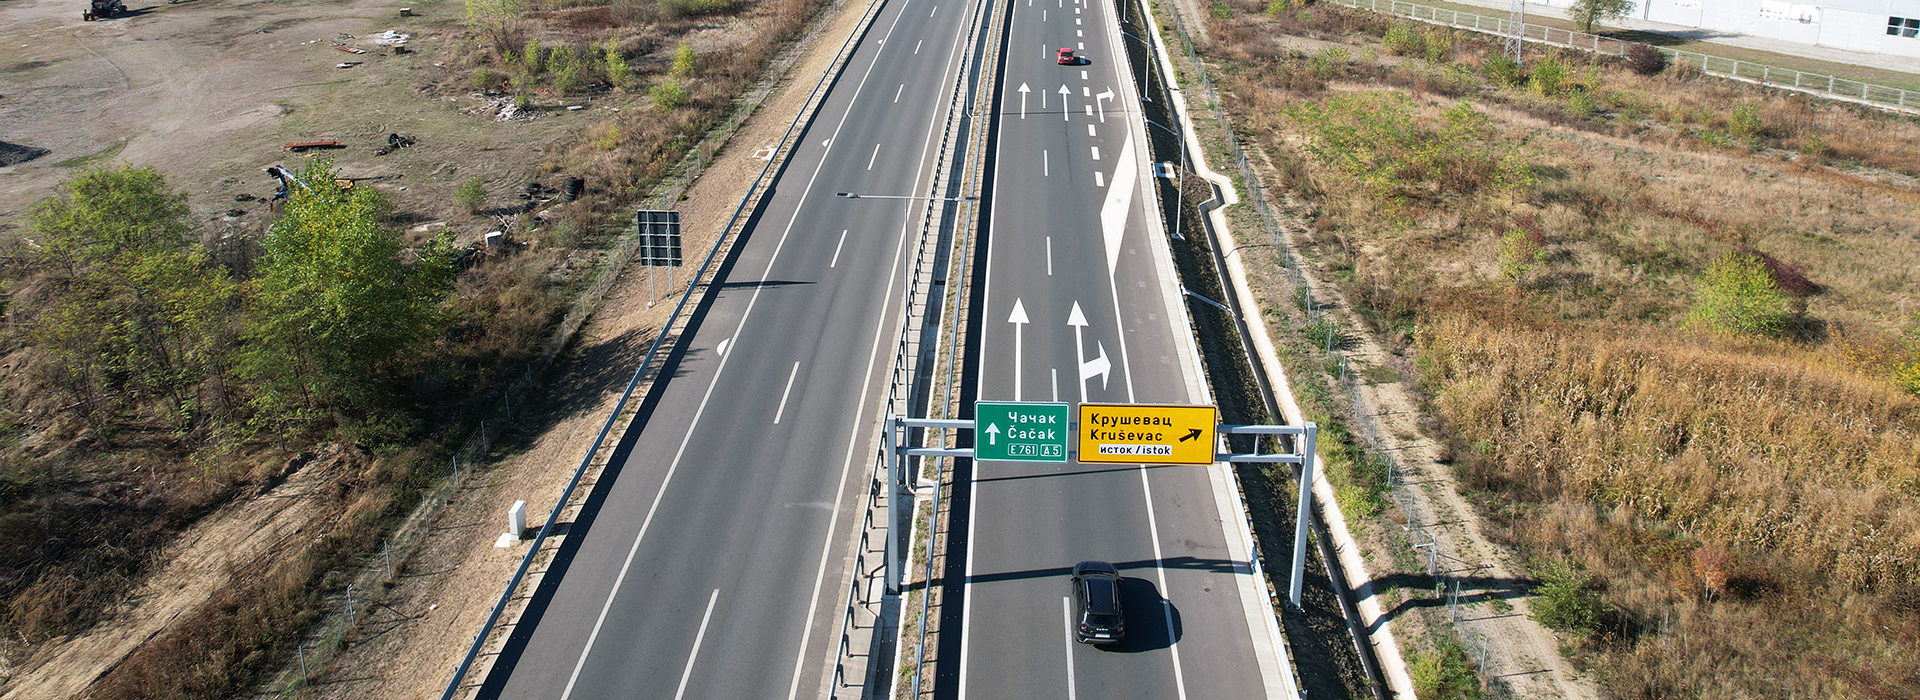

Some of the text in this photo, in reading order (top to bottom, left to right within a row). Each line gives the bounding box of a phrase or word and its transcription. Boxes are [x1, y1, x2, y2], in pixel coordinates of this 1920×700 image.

[1008, 411, 1057, 424] Чачак
[1090, 413, 1173, 428] Крушевац
[1008, 425, 1056, 440] Čačak
[1090, 428, 1164, 442] Kruševac
[1010, 444, 1036, 455] E 761
[1043, 445, 1060, 456] A 5
[1100, 446, 1133, 455] исток
